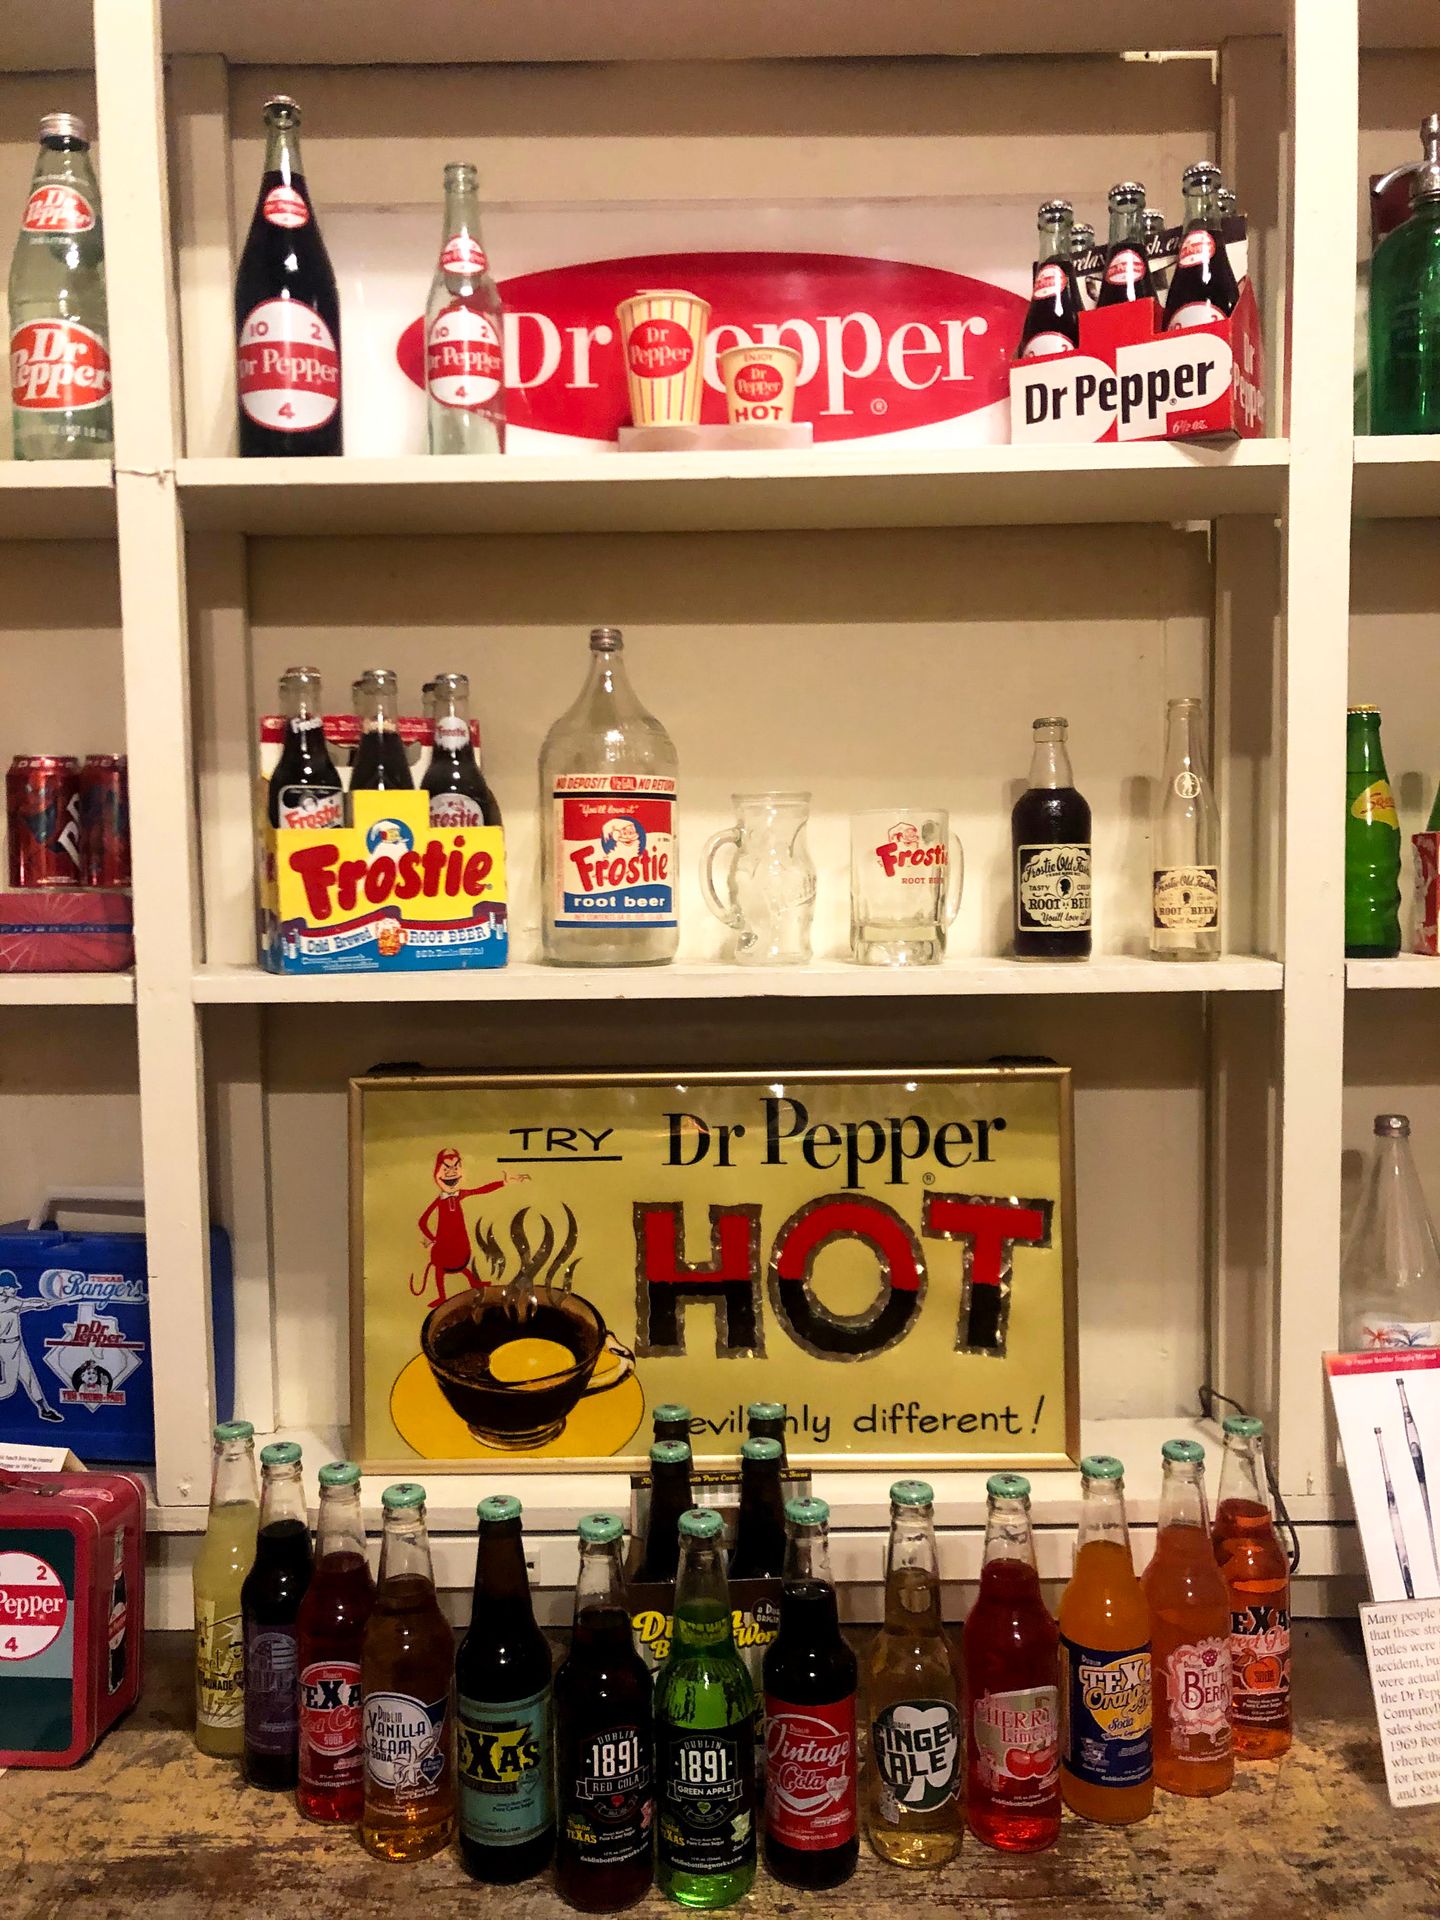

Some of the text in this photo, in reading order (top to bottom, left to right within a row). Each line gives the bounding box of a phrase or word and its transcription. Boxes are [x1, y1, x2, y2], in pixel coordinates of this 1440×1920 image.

[249, 322, 323, 340] 10 2
[480, 325, 490, 338] 2
[646, 327, 670, 343] Dr
[33, 328, 88, 362] Dr
[442, 345, 501, 373] Pepper
[503, 311, 989, 416] Dr epper
[630, 344, 692, 369] Pepper
[743, 353, 774, 362] ENJOY
[262, 348, 340, 384] Pepper
[749, 368, 767, 381] Dr
[10, 350, 111, 400] Pepper
[455, 385, 468, 398] 4
[737, 380, 782, 398] Pepper
[1025, 360, 1215, 425] Dr Pepper
[278, 402, 295, 420] 4
[735, 405, 784, 422] HOT
[556, 777, 675, 792] NO DEPOSIT NO RETURN
[569, 845, 669, 892] Frostie
[1023, 852, 1074, 883] Frostie Old
[289, 834, 494, 921] Frostie
[901, 877, 926, 885] ROOT
[1028, 884, 1051, 892] TASTY
[574, 896, 666, 907] root beer
[1028, 898, 1061, 910] ROOT
[1159, 906, 1215, 916] ROOT BEER
[306, 927, 372, 953] Cold Brewed
[409, 926, 486, 943] ROOT BEER
[509, 1096, 1008, 1190] TRY Dr Pepper
[632, 1189, 1056, 1364] HOT
[63, 1273, 144, 1310] Rangers
[71, 1323, 125, 1348] Pepper
[89, 1319, 110, 1335] Dr
[688, 1394, 1046, 1443] evilhly different!
[36, 1565, 48, 1581] 2
[0, 1590, 64, 1621] Pepper
[1367, 1607, 1435, 1626] Many people
[1369, 1629, 1391, 1641] that
[1393, 1626, 1420, 1639] these
[4, 1636, 19, 1653] 4
[1371, 1642, 1436, 1657] bottles were
[1375, 1658, 1424, 1673] accident,
[1377, 1677, 1405, 1688] were
[1380, 1691, 1398, 1704] the
[1400, 1689, 1415, 1702] Dr
[377, 1705, 403, 1724] DUBLIN
[367, 1709, 426, 1739] VANILLA
[1108, 1716, 1135, 1732] Soda
[1385, 1722, 1412, 1736] sales
[323, 1735, 343, 1746] SODA
[597, 1730, 636, 1746] DUBLIN
[684, 1739, 723, 1750] DUBLIN
[767, 1717, 849, 1768] Vintage
[1390, 1739, 1418, 1752] 1969
[371, 1752, 393, 1763] SODA
[591, 1736, 639, 1777] 1891
[1391, 1755, 1424, 1768] where
[679, 1748, 728, 1783] 1891
[886, 1746, 948, 1785] ALE
[592, 1773, 640, 1793] RED COLA
[778, 1761, 827, 1794] Cola
[1393, 1773, 1410, 1784] for
[677, 1784, 733, 1797] GREEN APPLE
[1396, 1786, 1418, 1801] and
